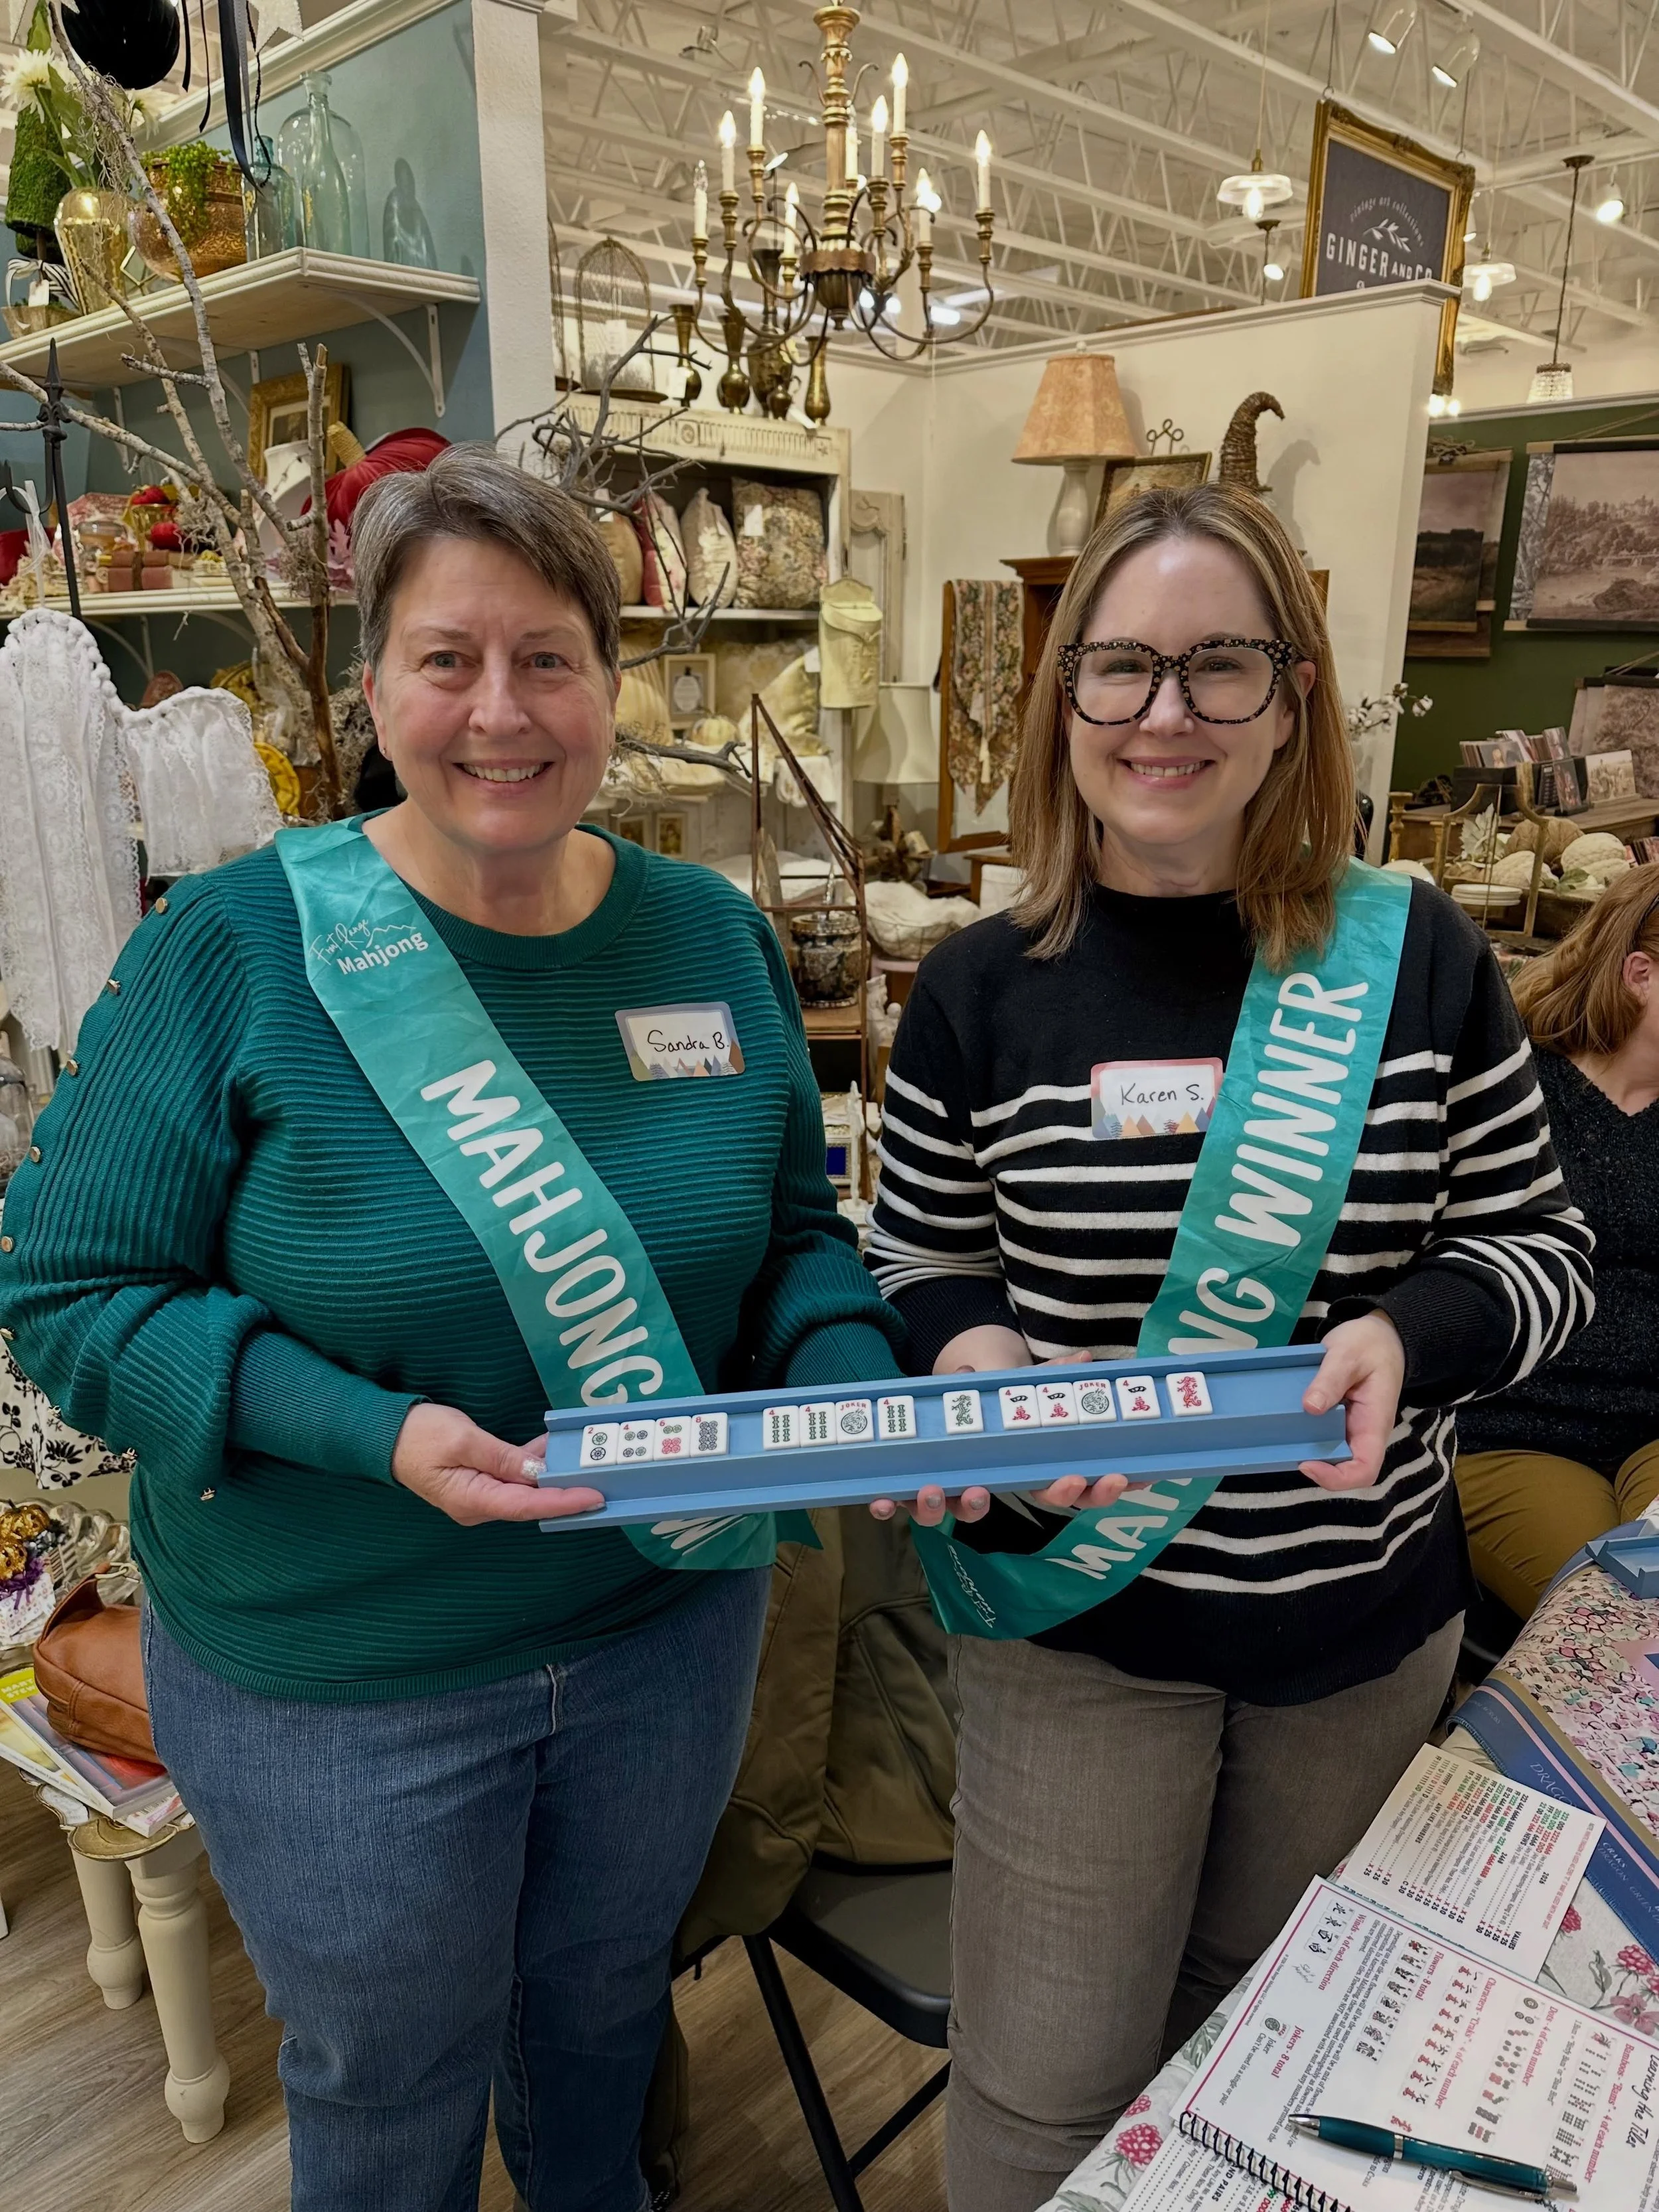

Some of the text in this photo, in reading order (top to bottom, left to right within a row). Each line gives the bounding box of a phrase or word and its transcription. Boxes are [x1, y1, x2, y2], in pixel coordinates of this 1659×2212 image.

[1326, 232, 1389, 278] GINGER
[1392, 261, 1412, 279] AND
[336, 932, 429, 975] Mahjong
[647, 1030, 729, 1052] Sandra B.
[1121, 1083, 1204, 1105] Karen S.
[1214, 972, 1368, 1247] WINNER
[419, 1059, 664, 1406] MAHJONG
[840, 1402, 867, 1411] JOKER
[1, 1678, 33, 1694] MART
[7, 1685, 36, 1698] STEW
[1530, 1762, 1573, 1807] DRAGO
[1428, 1812, 1437, 1822] LIKE
[1510, 1810, 1520, 1821] 6666
[1532, 1814, 1540, 1823] 222
[1415, 1822, 1431, 1844] NUMBERS
[1504, 1821, 1514, 1832] 8888
[1536, 1825, 1544, 1834] 222
[1497, 1837, 1506, 1846] 222
[1520, 1832, 1532, 1846] NEWS
[1530, 1834, 1540, 1846] 6666
[1541, 1830, 1551, 1842] 2222
[1486, 1854, 1496, 1866] 6666
[1497, 1852, 1507, 1864] 2468
[1603, 1842, 1626, 1868] CRAKS
[1480, 1866, 1490, 1878] 8888
[1540, 1872, 1549, 1884] 2026
[1333, 1903, 1346, 1914] 北
[1325, 1917, 1342, 1927] 東
[1351, 1914, 1366, 1932] Winds
[1318, 1929, 1333, 1943] 西
[1386, 1931, 1403, 1953] Depending
[1508, 1931, 1521, 1950] VALUES
[1309, 1943, 1326, 1954] 南
[1342, 1940, 1350, 1949] of
[1334, 1947, 1346, 1962] each
[1427, 1951, 1444, 1975] Flowers
[1319, 1962, 1339, 1990] direction
[1347, 1976, 1360, 1994] Flowers
[1364, 1982, 1376, 1999] flowers
[1415, 1984, 1427, 2000] total
[1476, 1978, 1496, 2012] Characters
[1337, 2002, 1347, 2014] NOT
[1546, 2006, 1558, 2022] Dots
[1299, 1957, 1379, 2105] American Mahjong, these used flowers
[1323, 2013, 1339, 2039] associated
[1254, 2033, 1266, 2046] Can't
[1287, 2026, 1304, 2049] Jokers
[1317, 2038, 1327, 2049] with
[1539, 2031, 1548, 2041] of
[1263, 2037, 1276, 2054] Joker
[1533, 2039, 1544, 2056] each
[1244, 2053, 1254, 2065] used
[1455, 2052, 1463, 2063] of
[1617, 2043, 1634, 2076] Bamboos
[1271, 2060, 1285, 2078] total
[1447, 2060, 1459, 2077] each
[1522, 2056, 1538, 2087] number
[1230, 2073, 1241, 2089] single
[1298, 2073, 1307, 2085] any
[1220, 2093, 1228, 2105] pair
[1287, 2084, 1302, 2107] numbers
[1435, 2078, 1451, 2109] number
[1276, 2105, 1290, 2127] printed
[1634, 2101, 1654, 2120] the
[1601, 2121, 1609, 2132] of
[1595, 2130, 1605, 2148] each
[1626, 2122, 1648, 2148] Tiles
[1189, 2148, 1198, 2158] Any
[1176, 2161, 1190, 2178] Consec.
[1417, 2165, 1428, 2179] zero
[1585, 2149, 1599, 2183] number
[1166, 2179, 1179, 2193] Nos.)
[1185, 2164, 1214, 2203] These Nos. Only)
[1362, 2171, 1375, 2187] Craks
[1423, 2169, 1437, 2193] neutral
[1212, 2179, 1228, 2201] PAIRS
